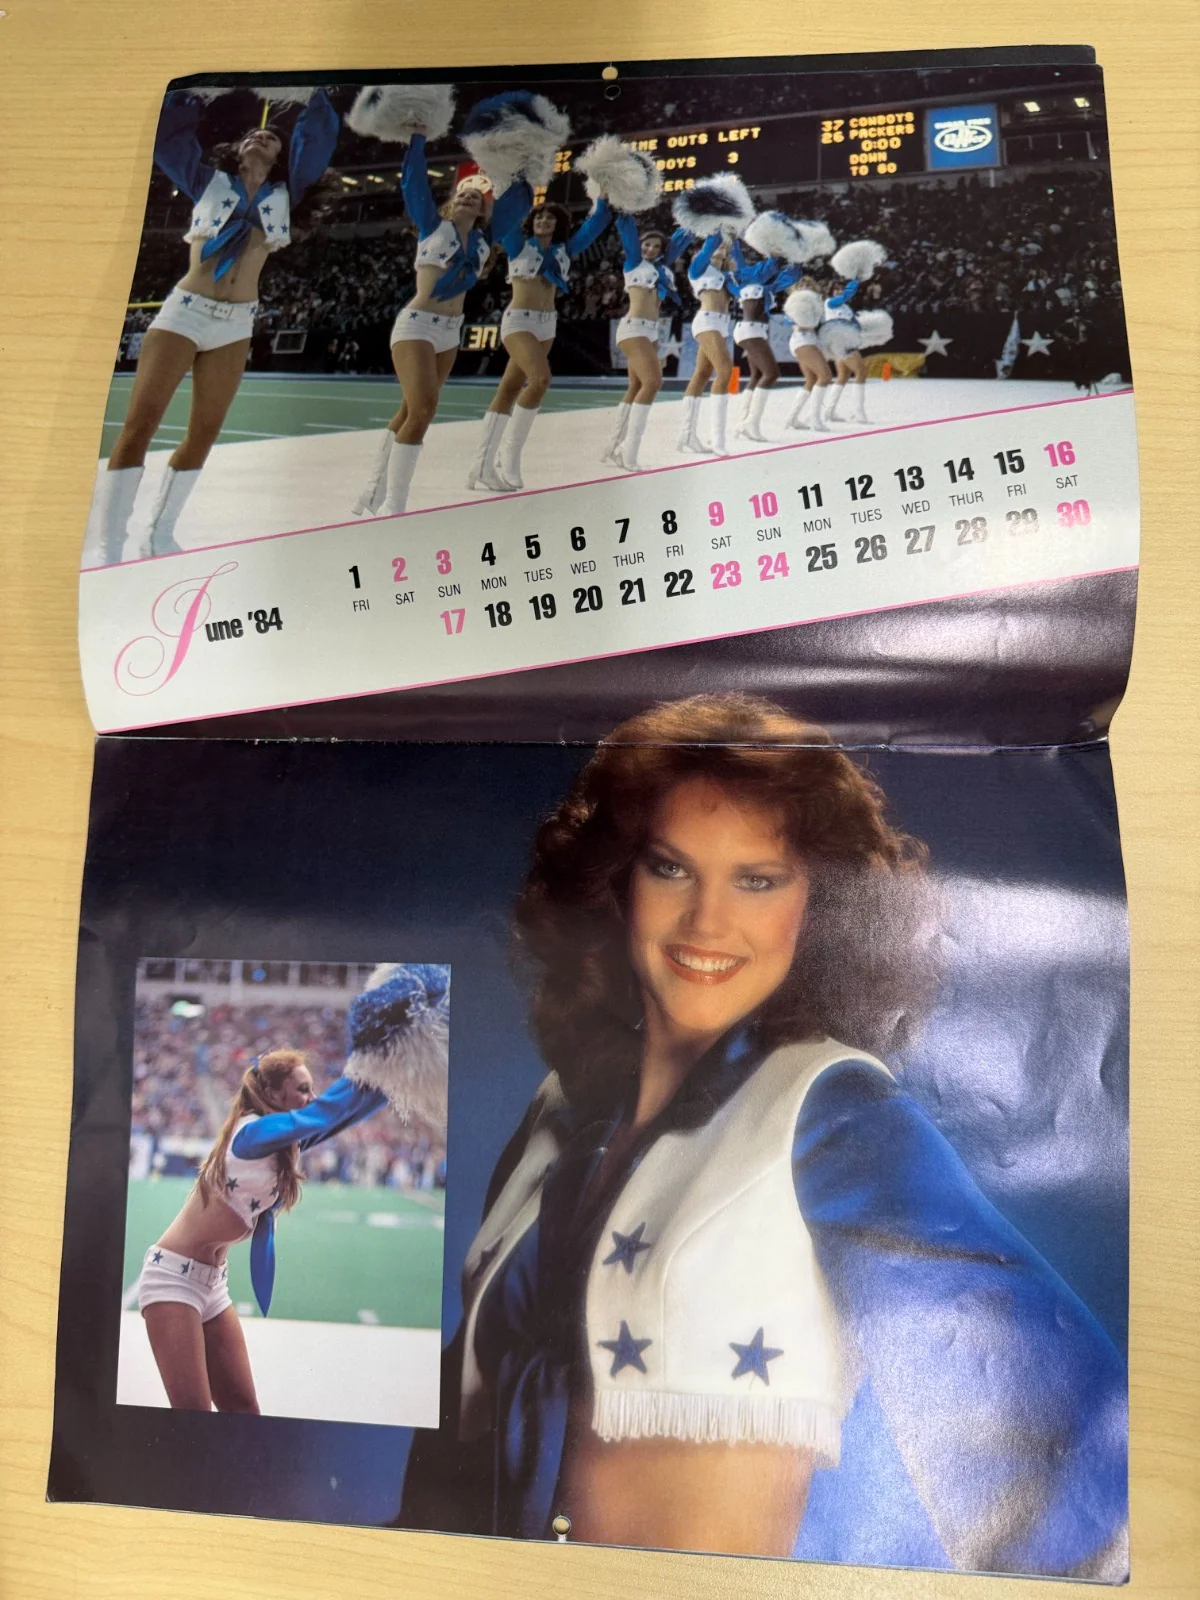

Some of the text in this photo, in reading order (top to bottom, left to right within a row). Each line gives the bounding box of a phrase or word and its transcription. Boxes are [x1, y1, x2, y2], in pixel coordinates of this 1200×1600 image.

[821, 119, 845, 132] 37
[821, 123, 915, 144] 26 PACKERS
[667, 133, 708, 148] OUTS
[718, 127, 761, 142] LEFT
[861, 137, 902, 152] 0:00
[655, 151, 739, 171] BOYS 3
[849, 151, 887, 165] DOWN
[850, 165, 870, 177] TO
[349, 440, 1077, 589] 1 2 3 4 5 6 7 8 9 10 11 12 13 14 15 16
[353, 474, 1079, 613] FRI SAT SUN MON TUES WED THUR FRI SAT SUN MON TUES WED THUR FRI SAT
[440, 607, 466, 636] 17
[484, 600, 513, 629] 18
[529, 592, 558, 621] 19
[573, 584, 604, 615] 20
[619, 576, 647, 607] 21
[664, 568, 696, 599] 22
[710, 560, 743, 590] 23
[758, 551, 791, 582] 24
[806, 542, 839, 573] 25
[855, 533, 888, 565] 26
[905, 524, 936, 556] 27
[955, 516, 989, 547] 28
[1057, 499, 1092, 529] 30
[114, 561, 284, 697] June '84
